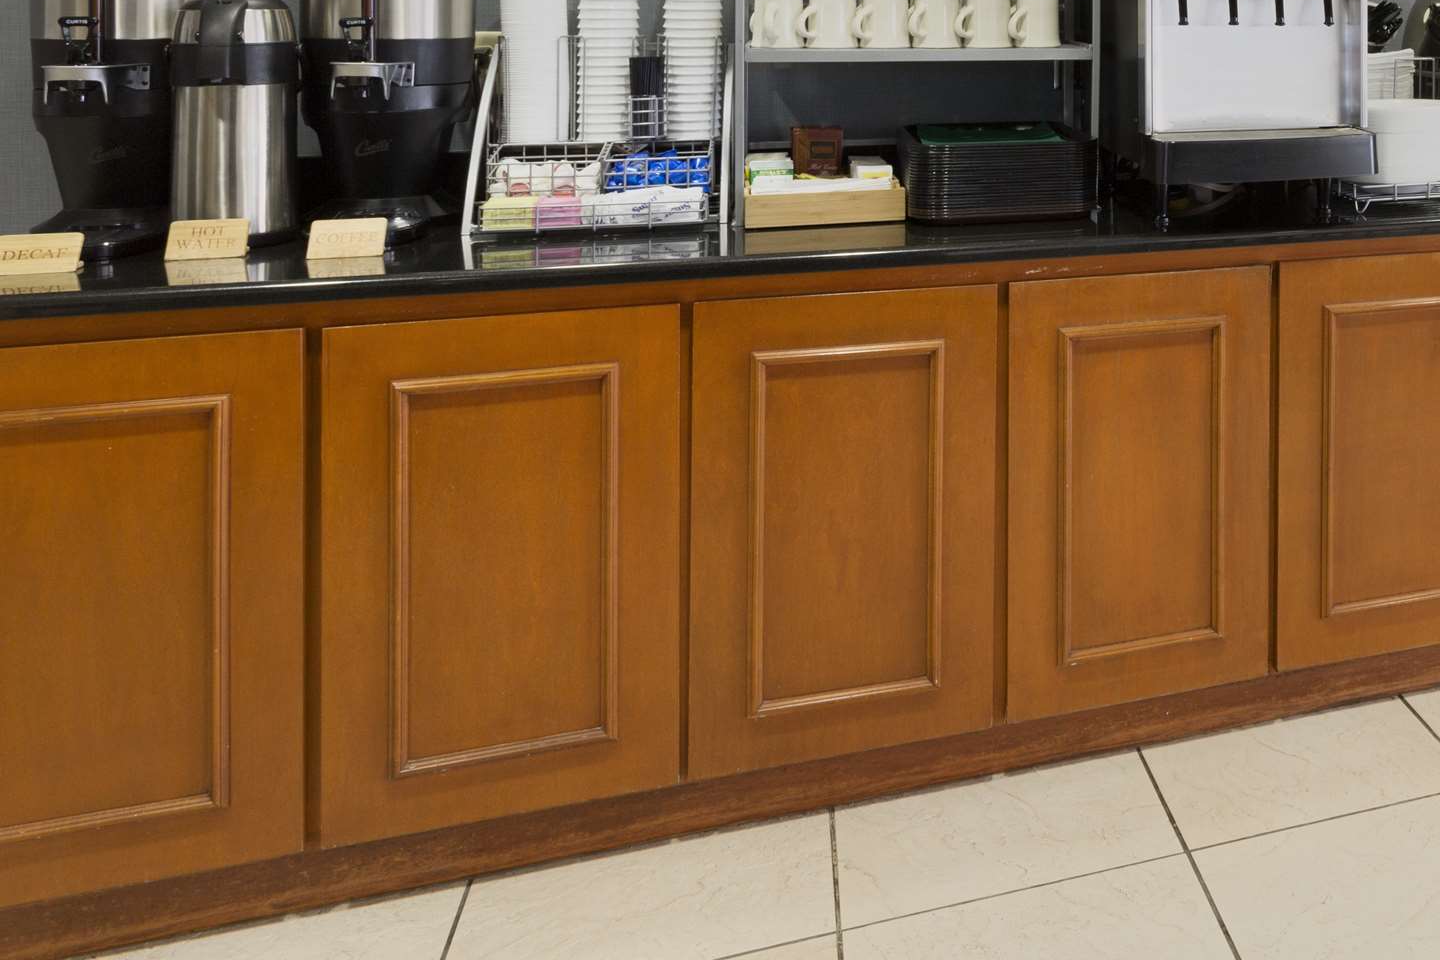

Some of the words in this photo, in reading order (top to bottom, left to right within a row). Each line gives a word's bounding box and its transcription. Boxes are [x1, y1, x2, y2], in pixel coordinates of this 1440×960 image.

[192, 225, 224, 238] HOT
[315, 231, 378, 244] COFFEE
[176, 238, 236, 250] WATER
[2, 247, 69, 261] DECAF
